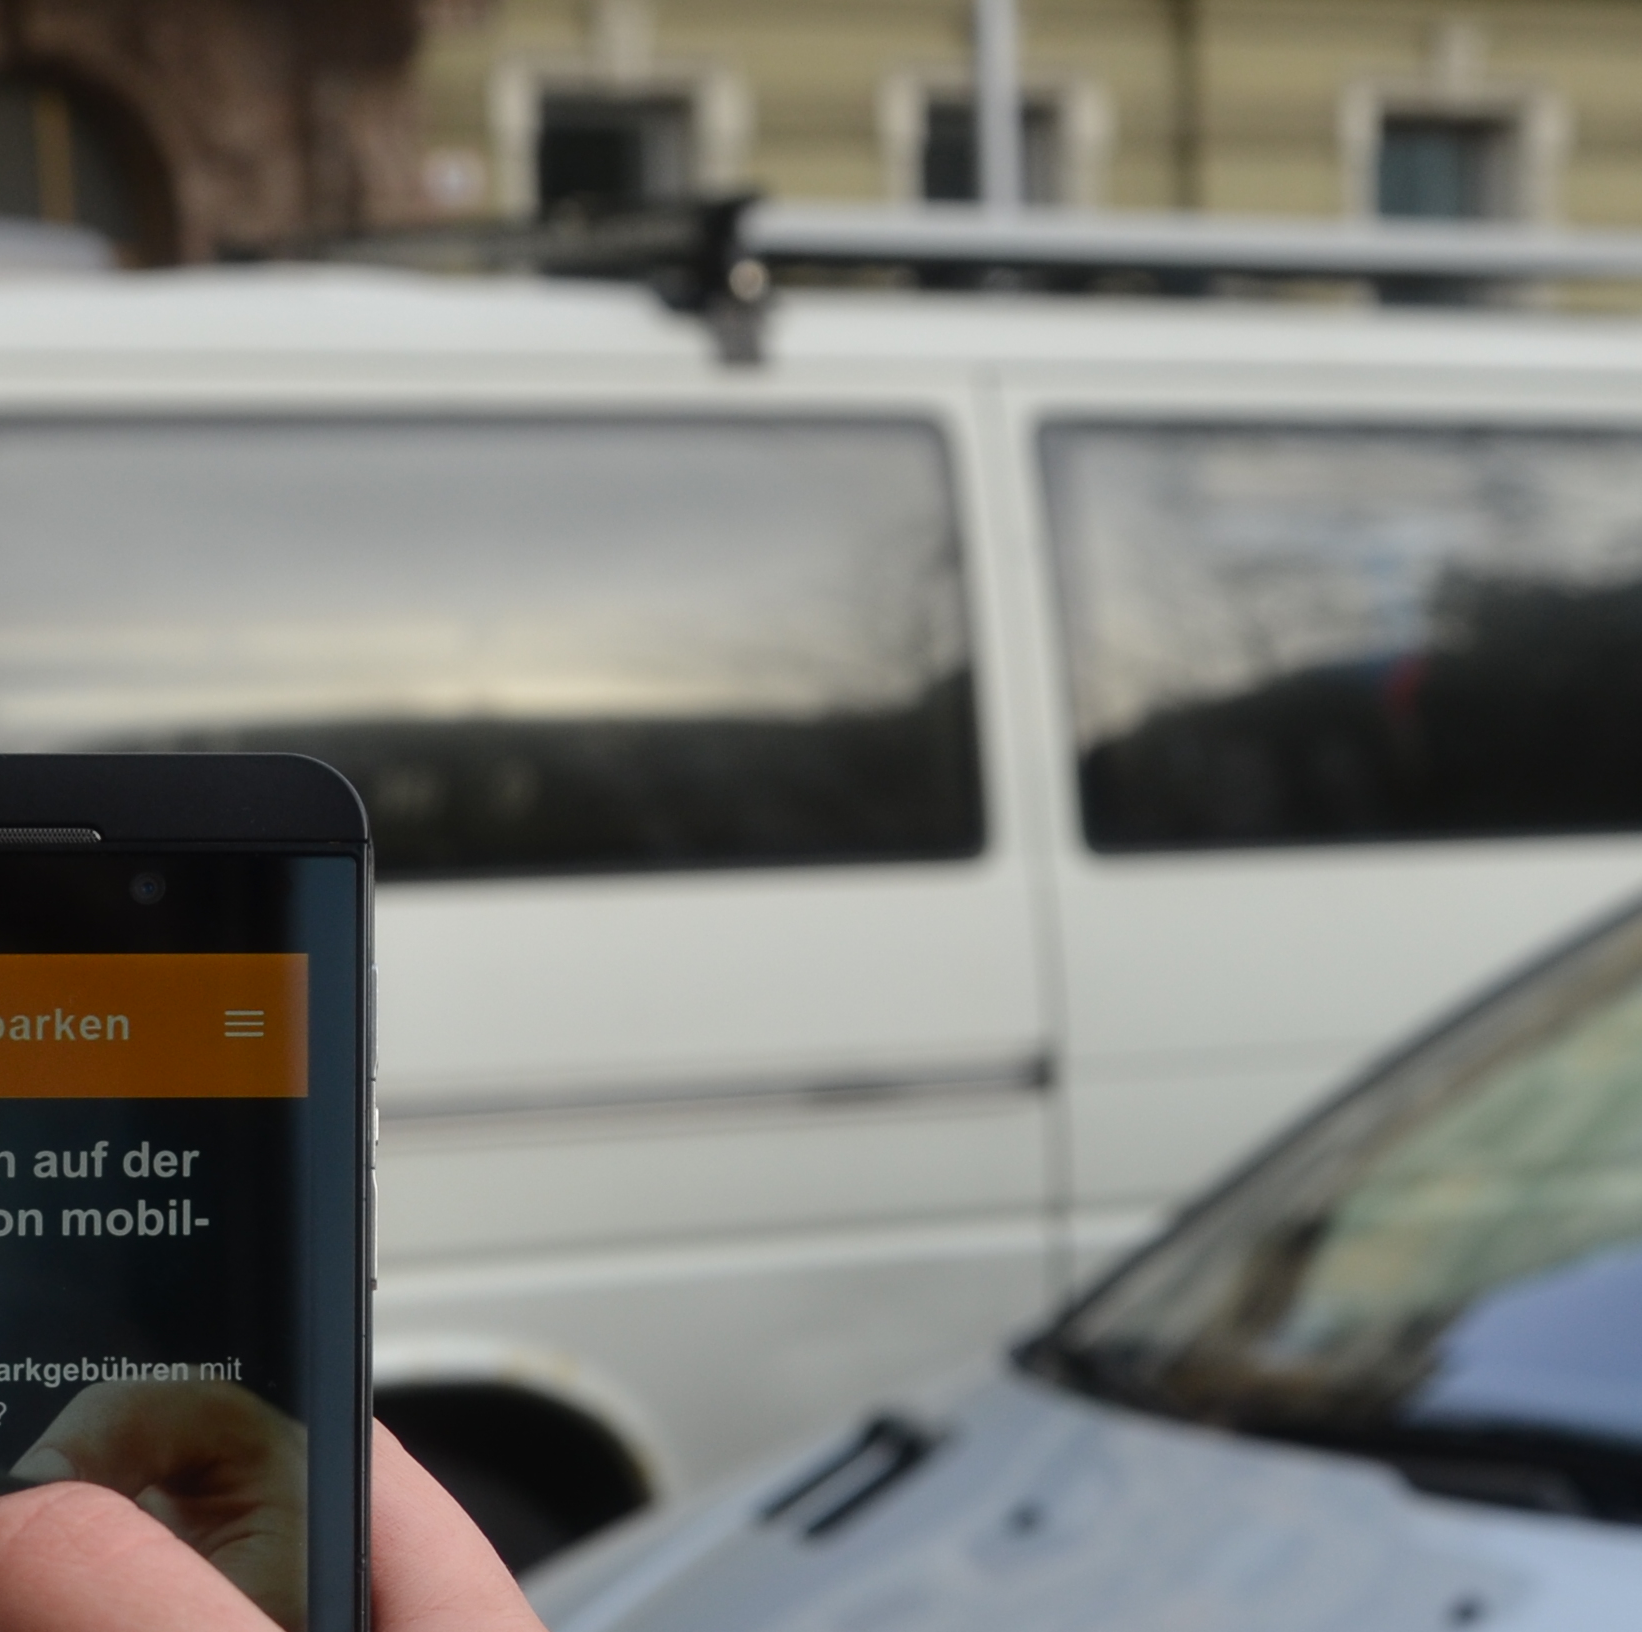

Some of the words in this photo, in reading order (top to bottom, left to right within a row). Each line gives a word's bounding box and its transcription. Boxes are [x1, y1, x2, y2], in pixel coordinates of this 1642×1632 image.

[34, 1141, 110, 1179] auf
[123, 1141, 200, 1179] der
[62, 1199, 210, 1237] mobil-
[199, 1356, 243, 1381] mit
